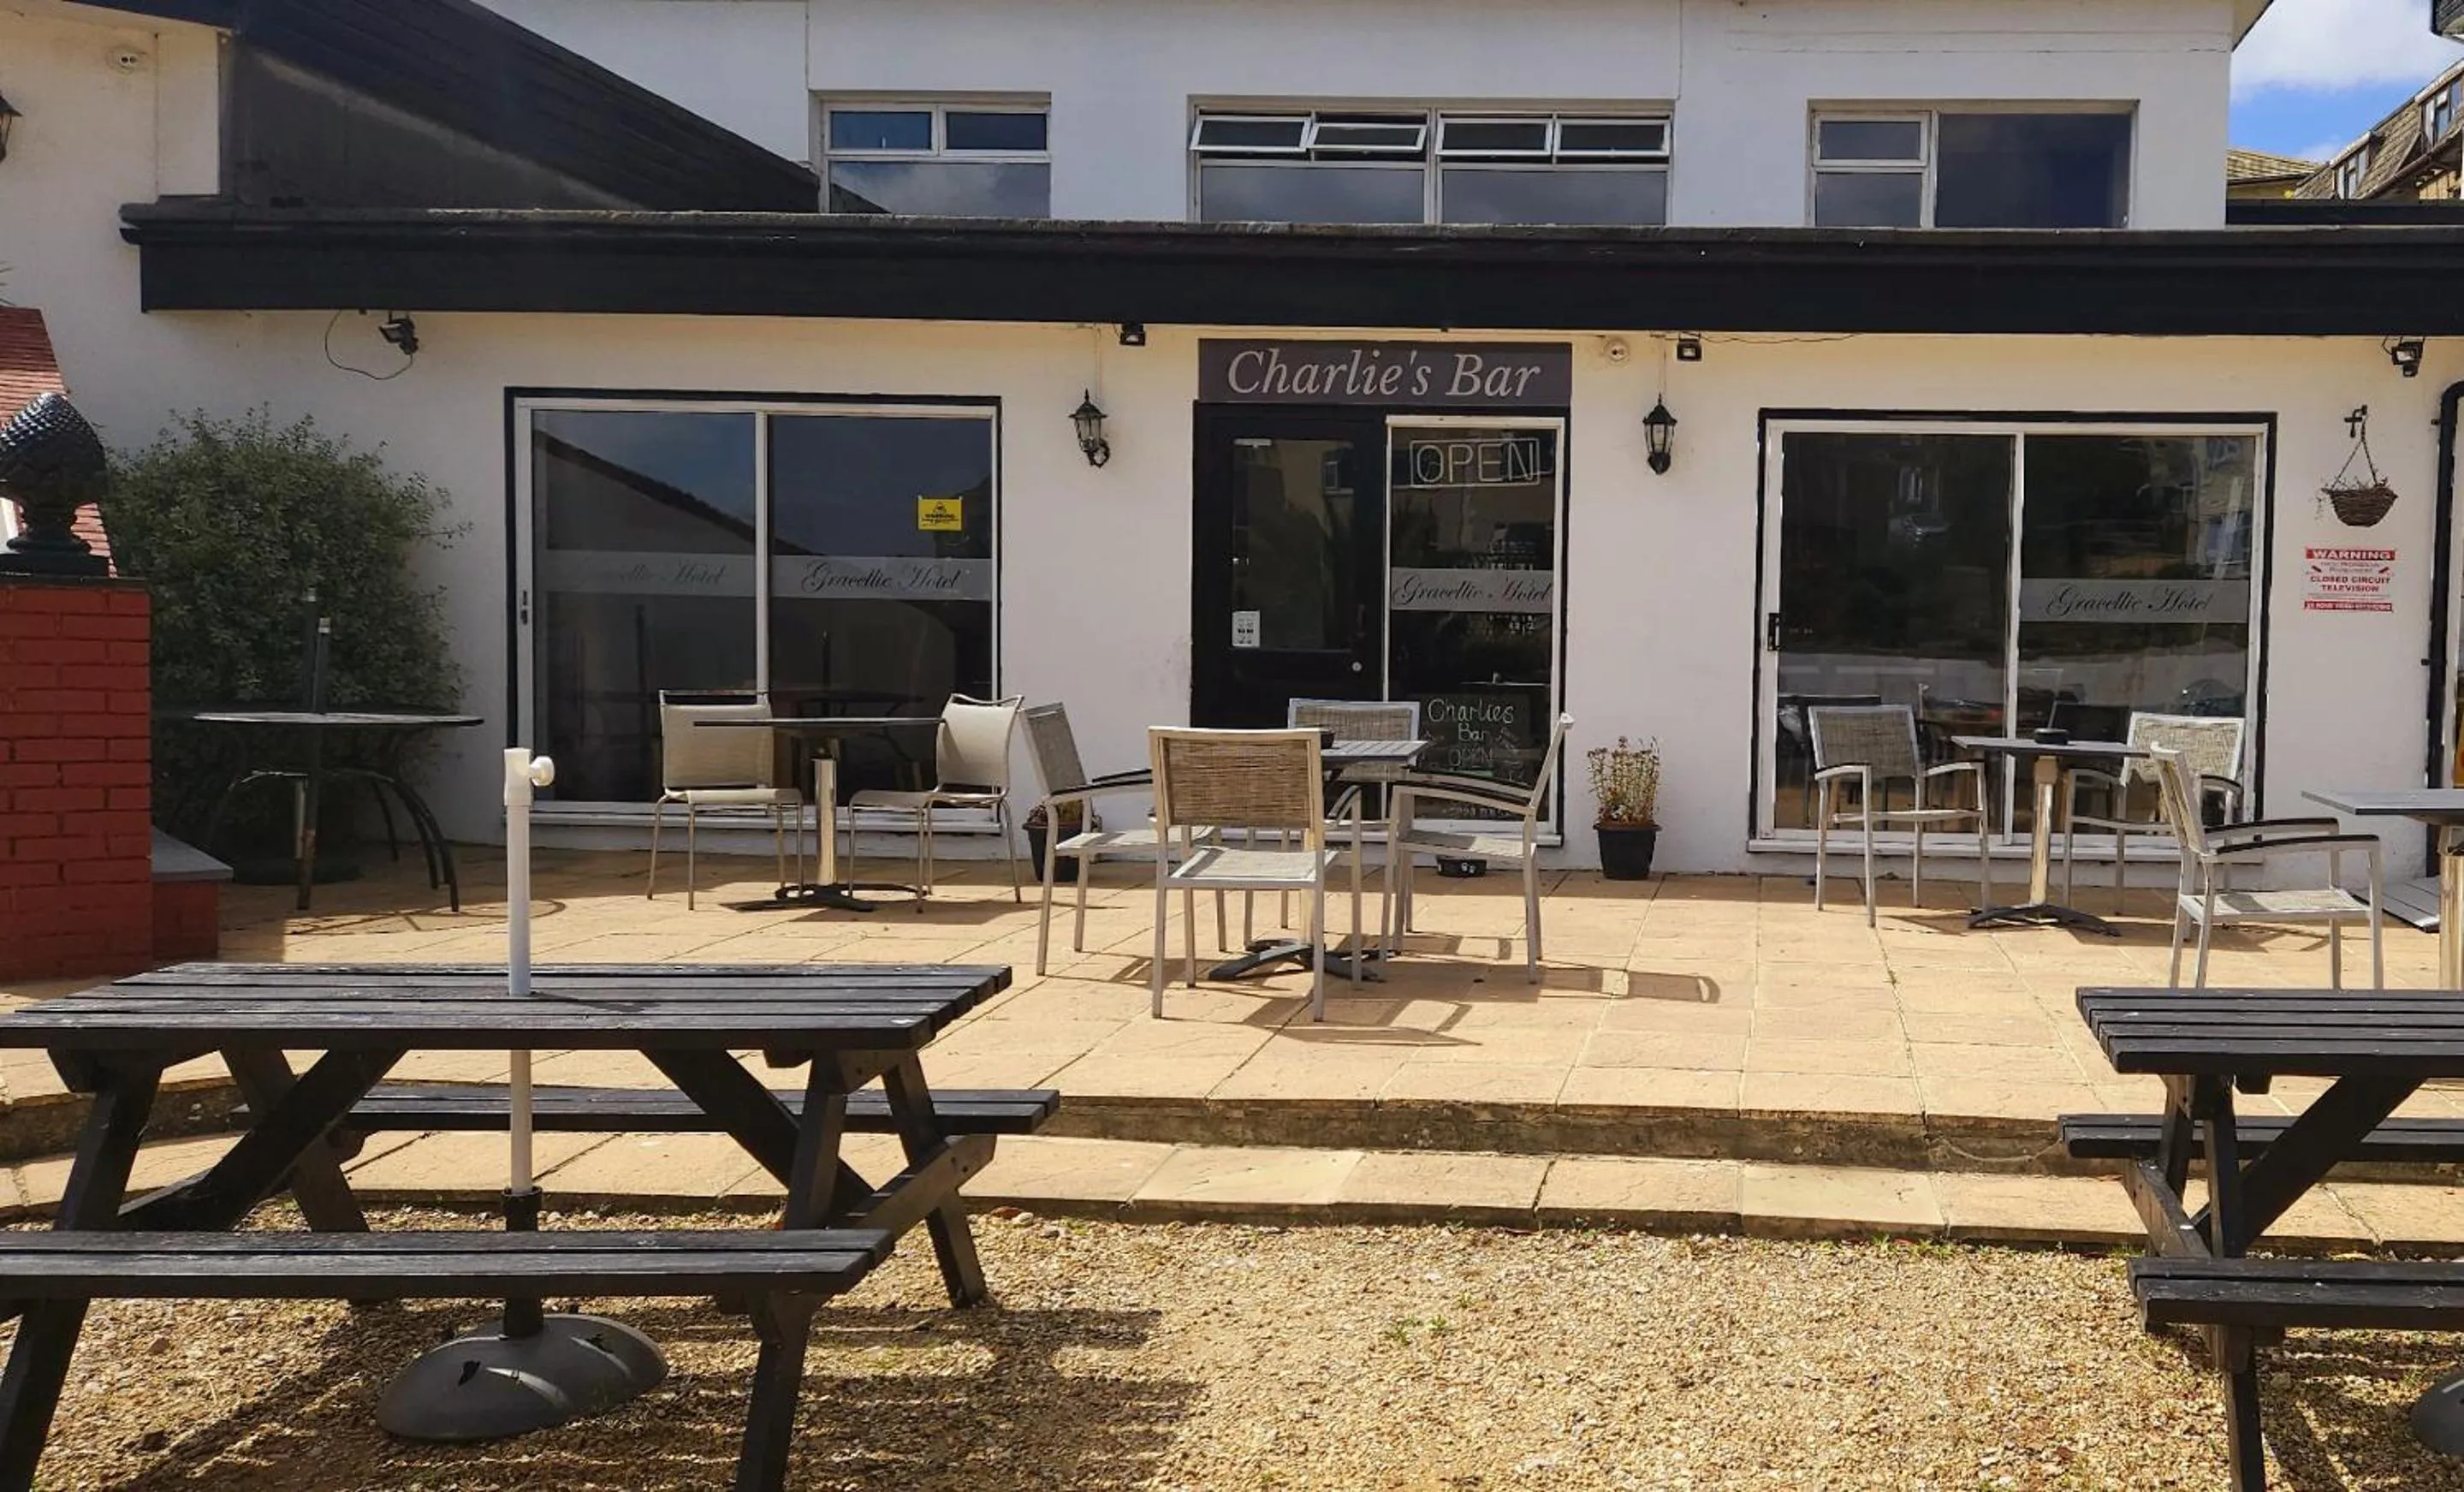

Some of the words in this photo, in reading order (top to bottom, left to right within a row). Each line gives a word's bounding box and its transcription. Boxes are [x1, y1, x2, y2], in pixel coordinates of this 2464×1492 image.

[1227, 348, 1432, 395] Charlie's
[1446, 353, 1540, 397] Bar
[1416, 441, 1535, 484] OPEN
[2313, 550, 2391, 560] WARNING
[900, 565, 962, 590] Hotel
[2311, 574, 2348, 583] CLOSED
[2322, 584, 2379, 592] TELEVISION
[2147, 586, 2213, 612] Hotel
[1428, 698, 1514, 724] Charlies
[1458, 722, 1487, 742] Bar
